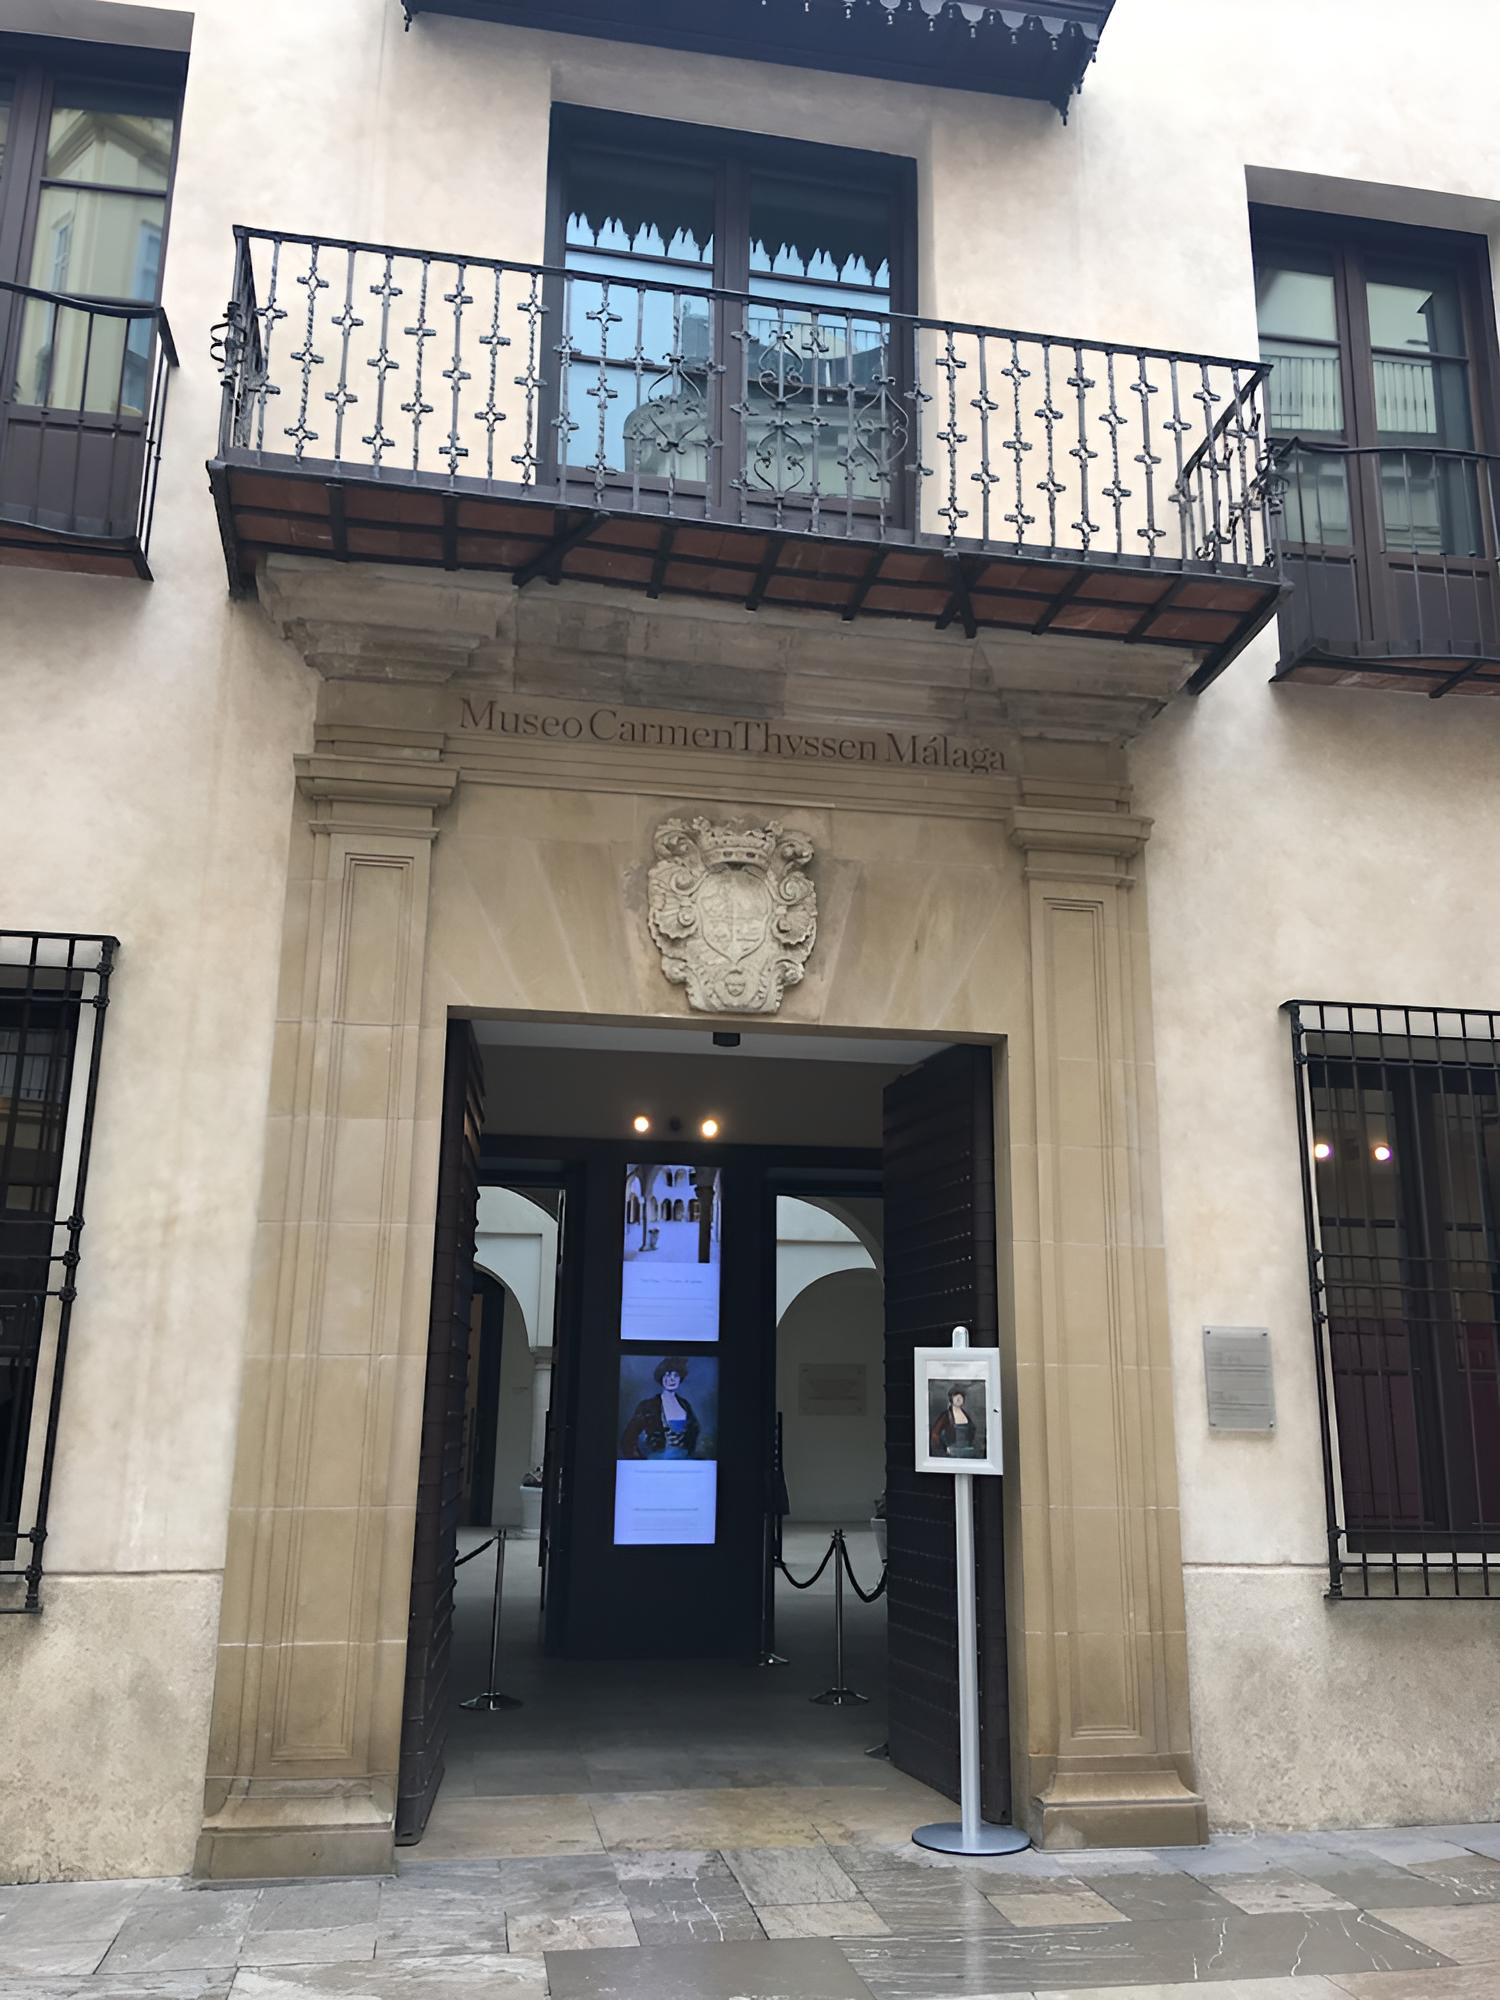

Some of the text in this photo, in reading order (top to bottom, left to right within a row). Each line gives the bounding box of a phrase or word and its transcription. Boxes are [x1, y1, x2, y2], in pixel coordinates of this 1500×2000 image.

[460, 697, 1006, 774] Museo Carmen Thyssen Málaga
